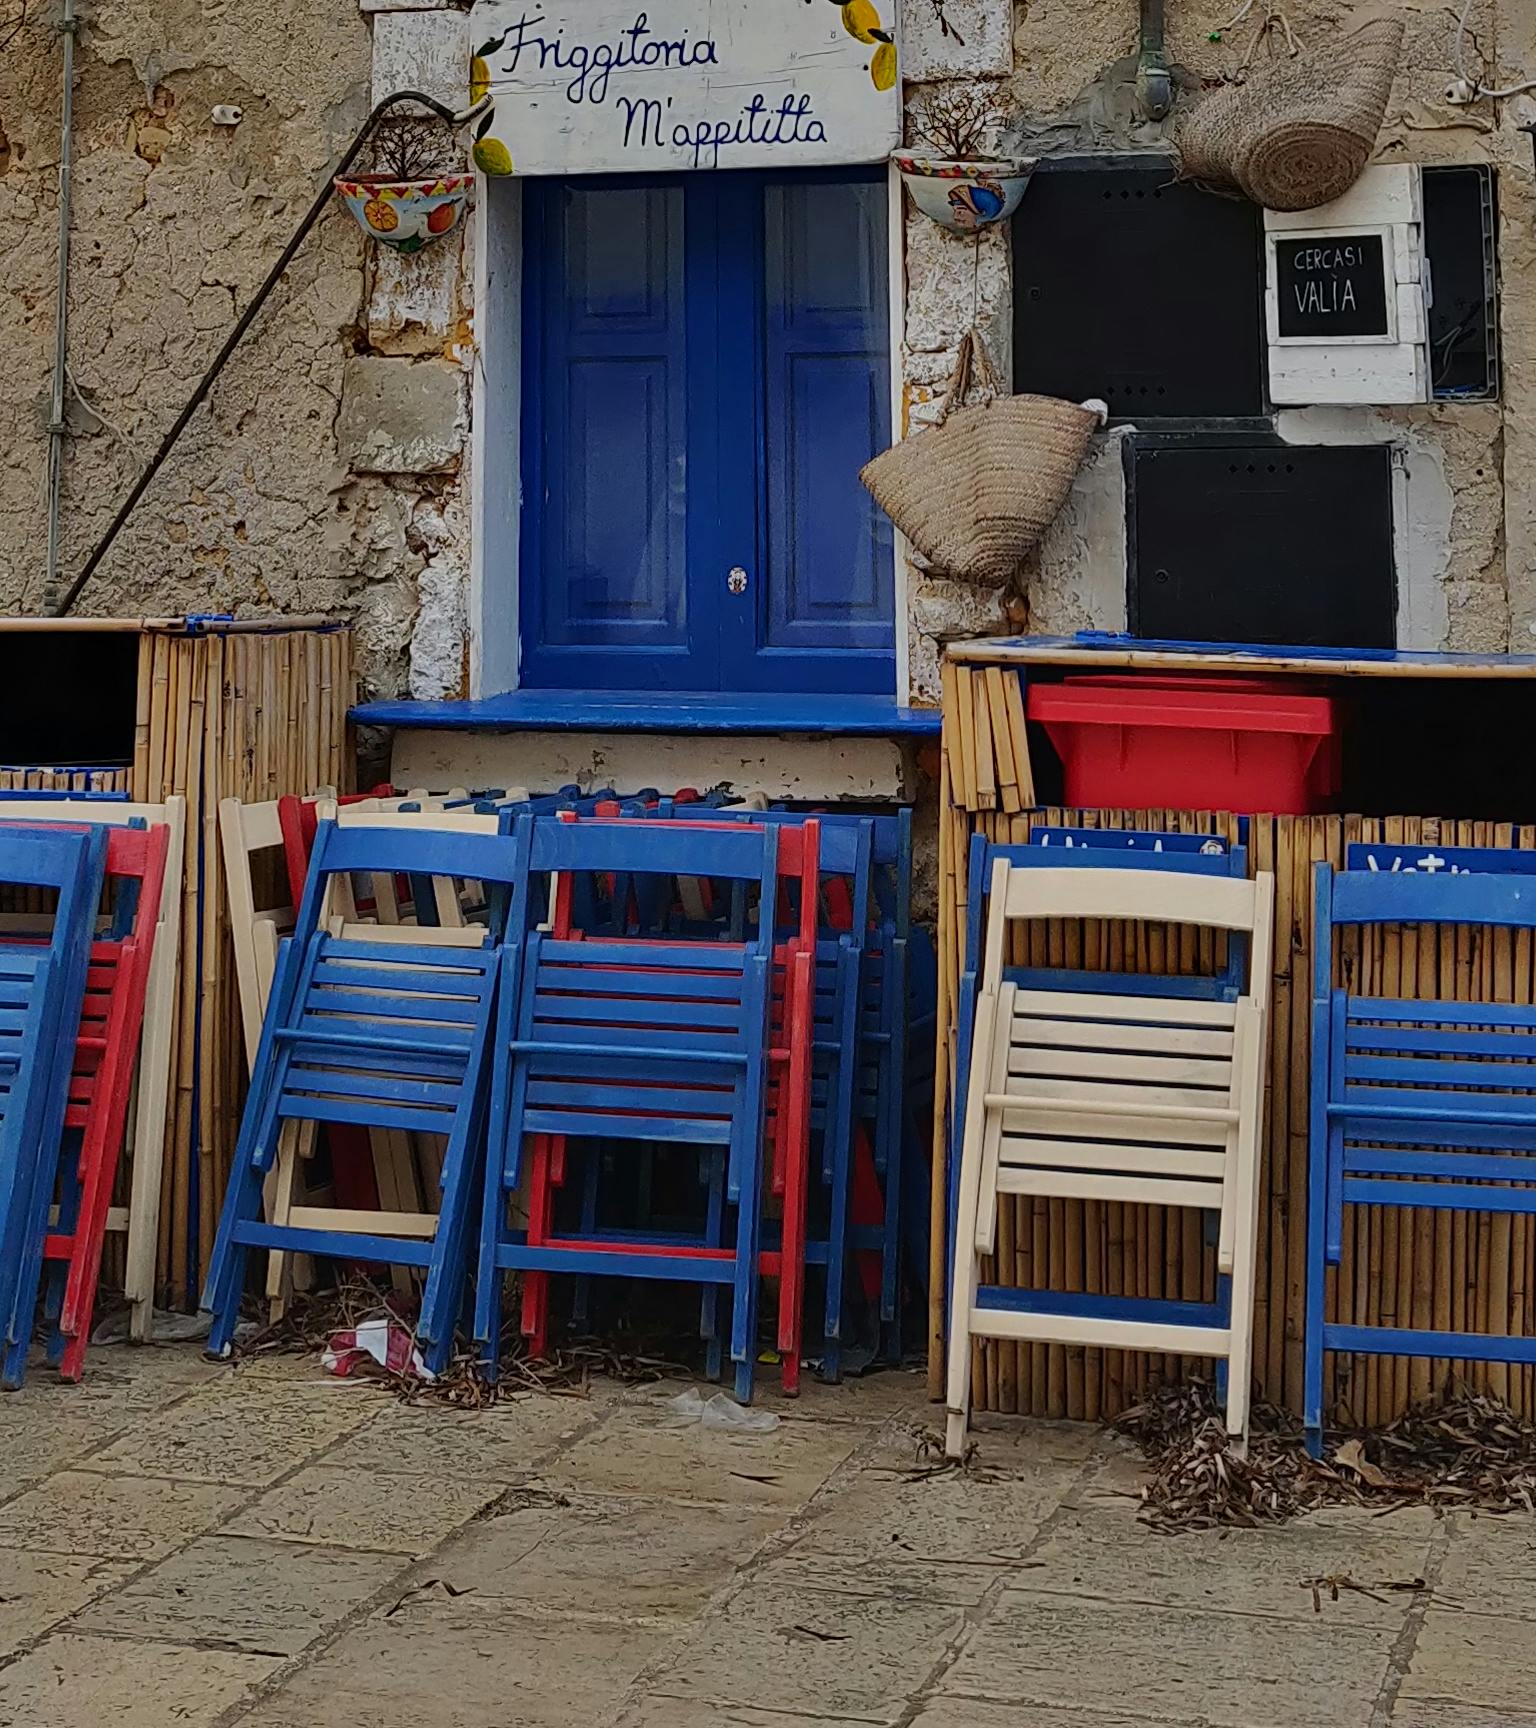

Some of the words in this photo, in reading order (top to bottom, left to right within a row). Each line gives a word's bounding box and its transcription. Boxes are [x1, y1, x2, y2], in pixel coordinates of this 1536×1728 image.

[501, 12, 719, 104] Friggitoria
[615, 93, 828, 168] M'appititta
[1294, 246, 1363, 271] CERCASI
